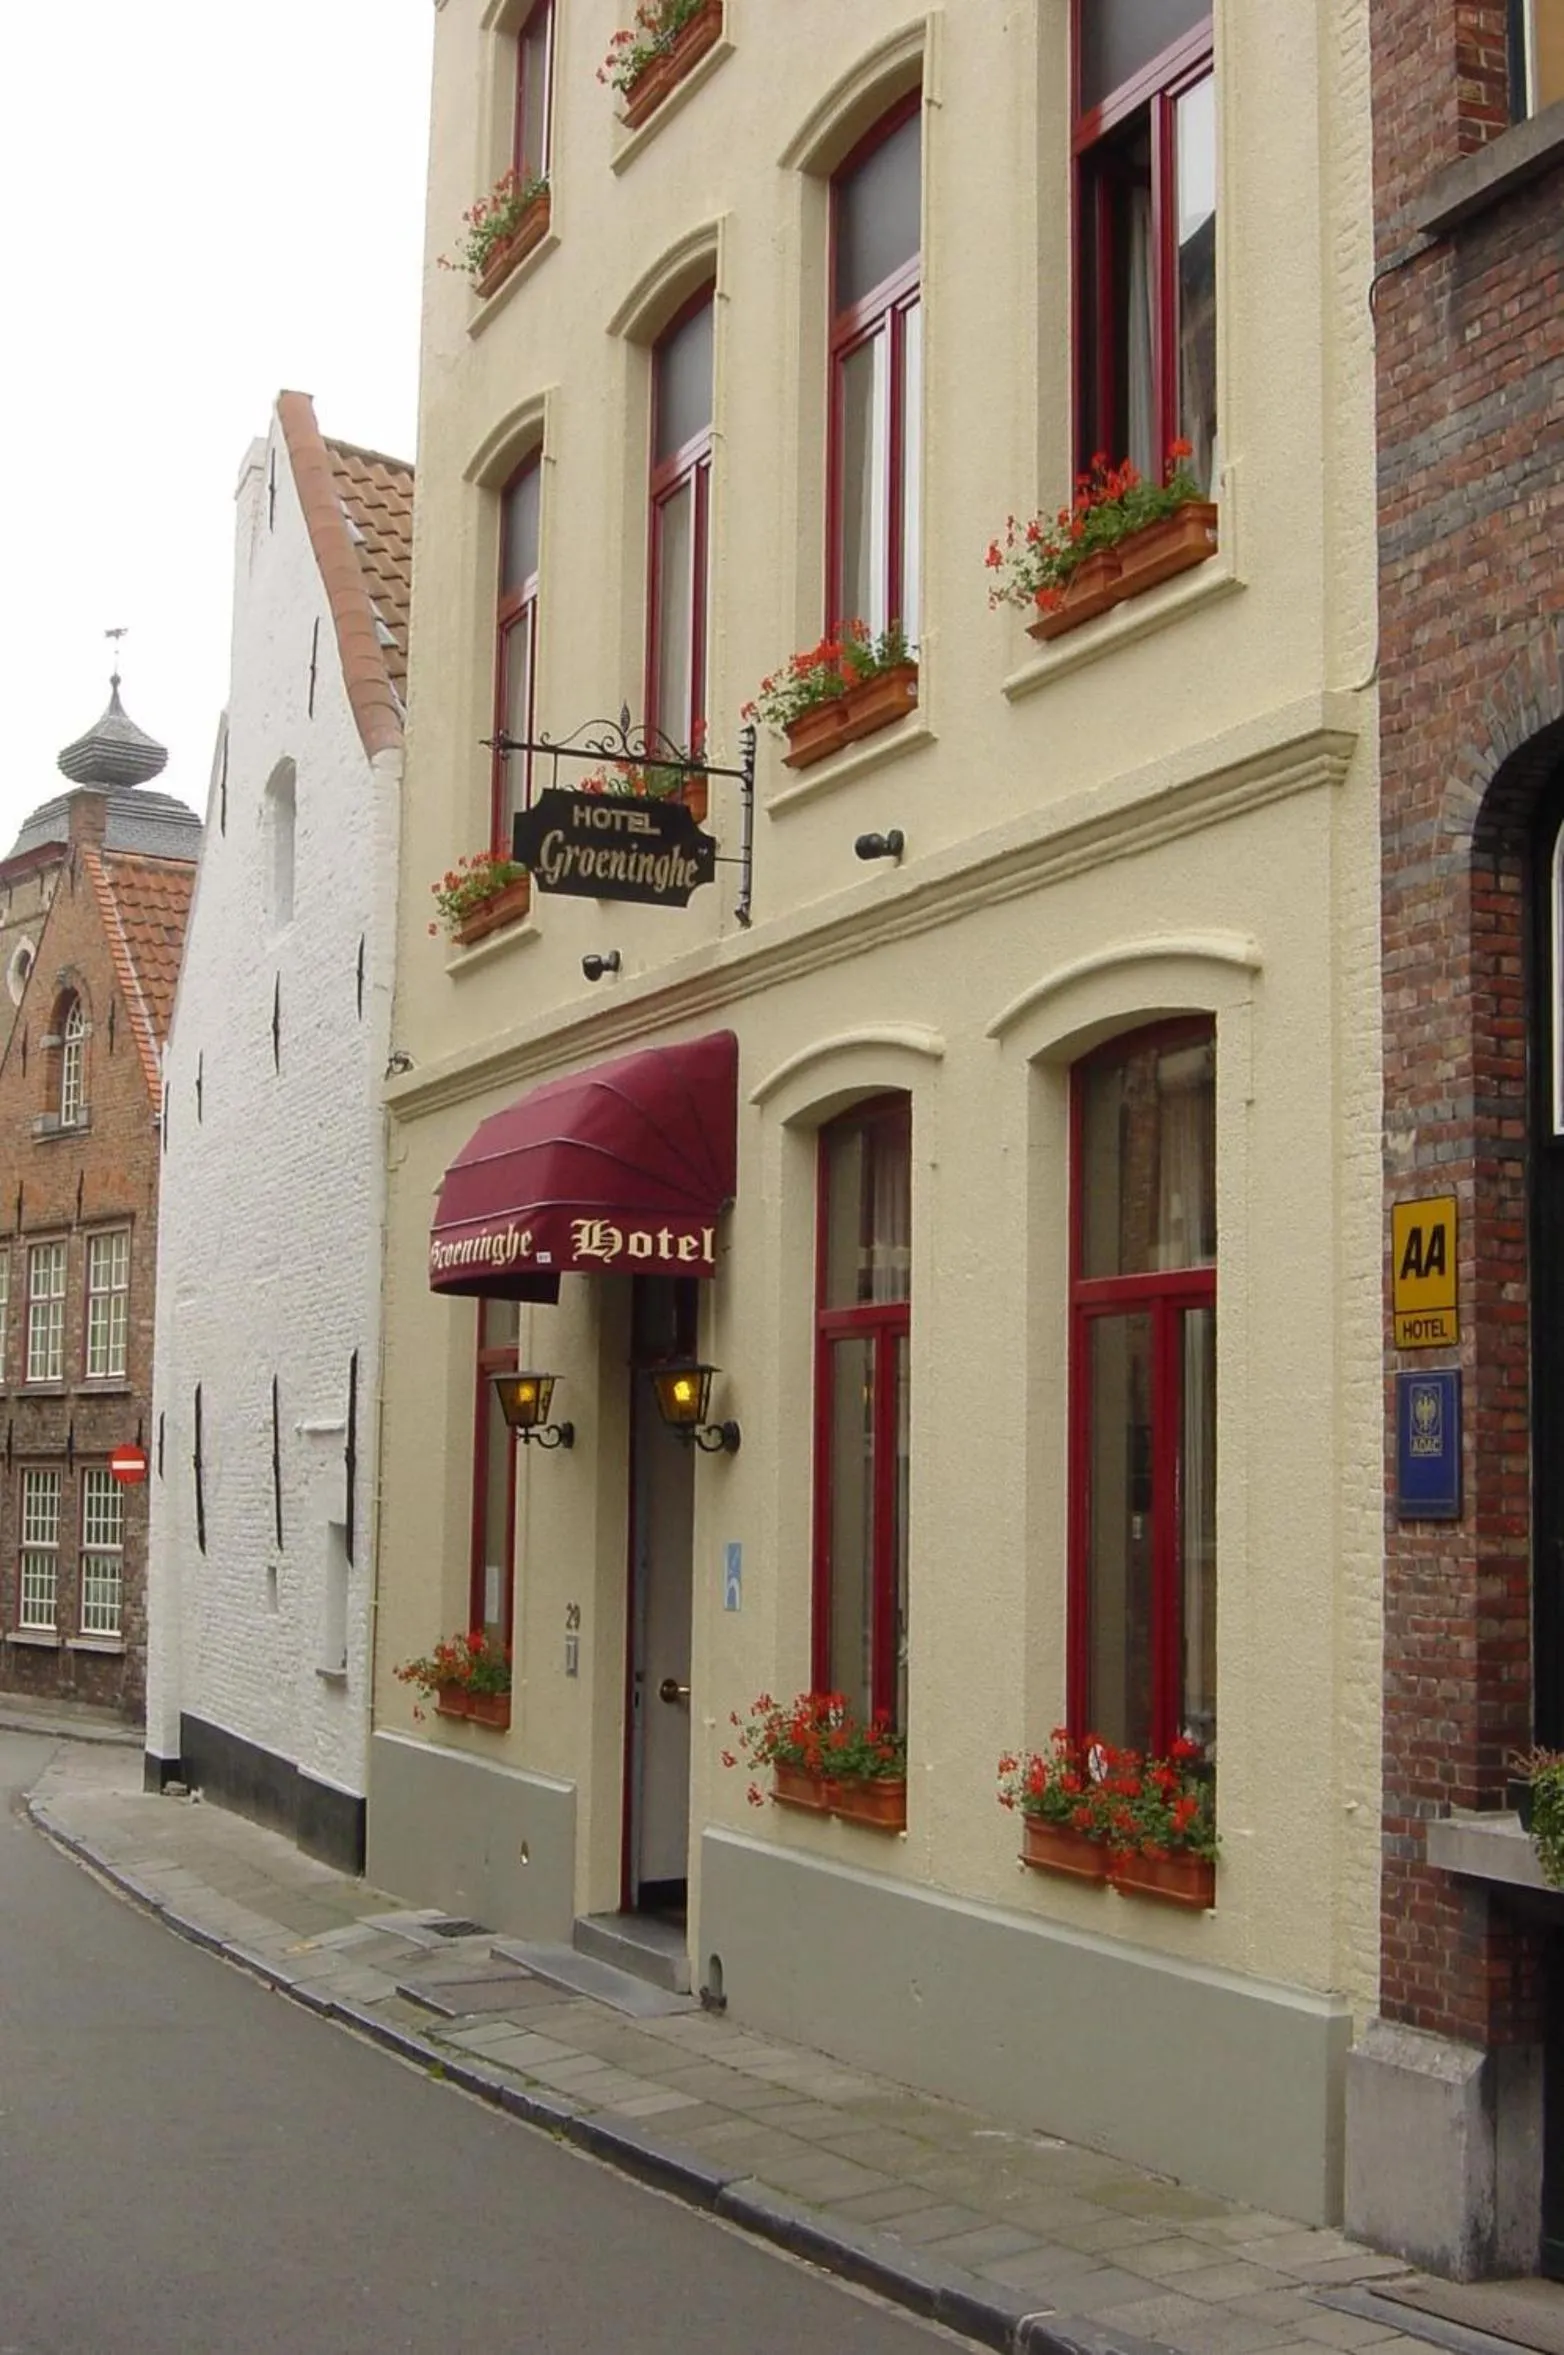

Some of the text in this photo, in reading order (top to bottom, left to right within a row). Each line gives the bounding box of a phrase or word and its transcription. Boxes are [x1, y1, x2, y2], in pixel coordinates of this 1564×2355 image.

[573, 805, 661, 835] HOTEL
[570, 1219, 715, 1263] Hotel
[1400, 1224, 1446, 1280] AA
[1403, 1319, 1448, 1341] HOTEL
